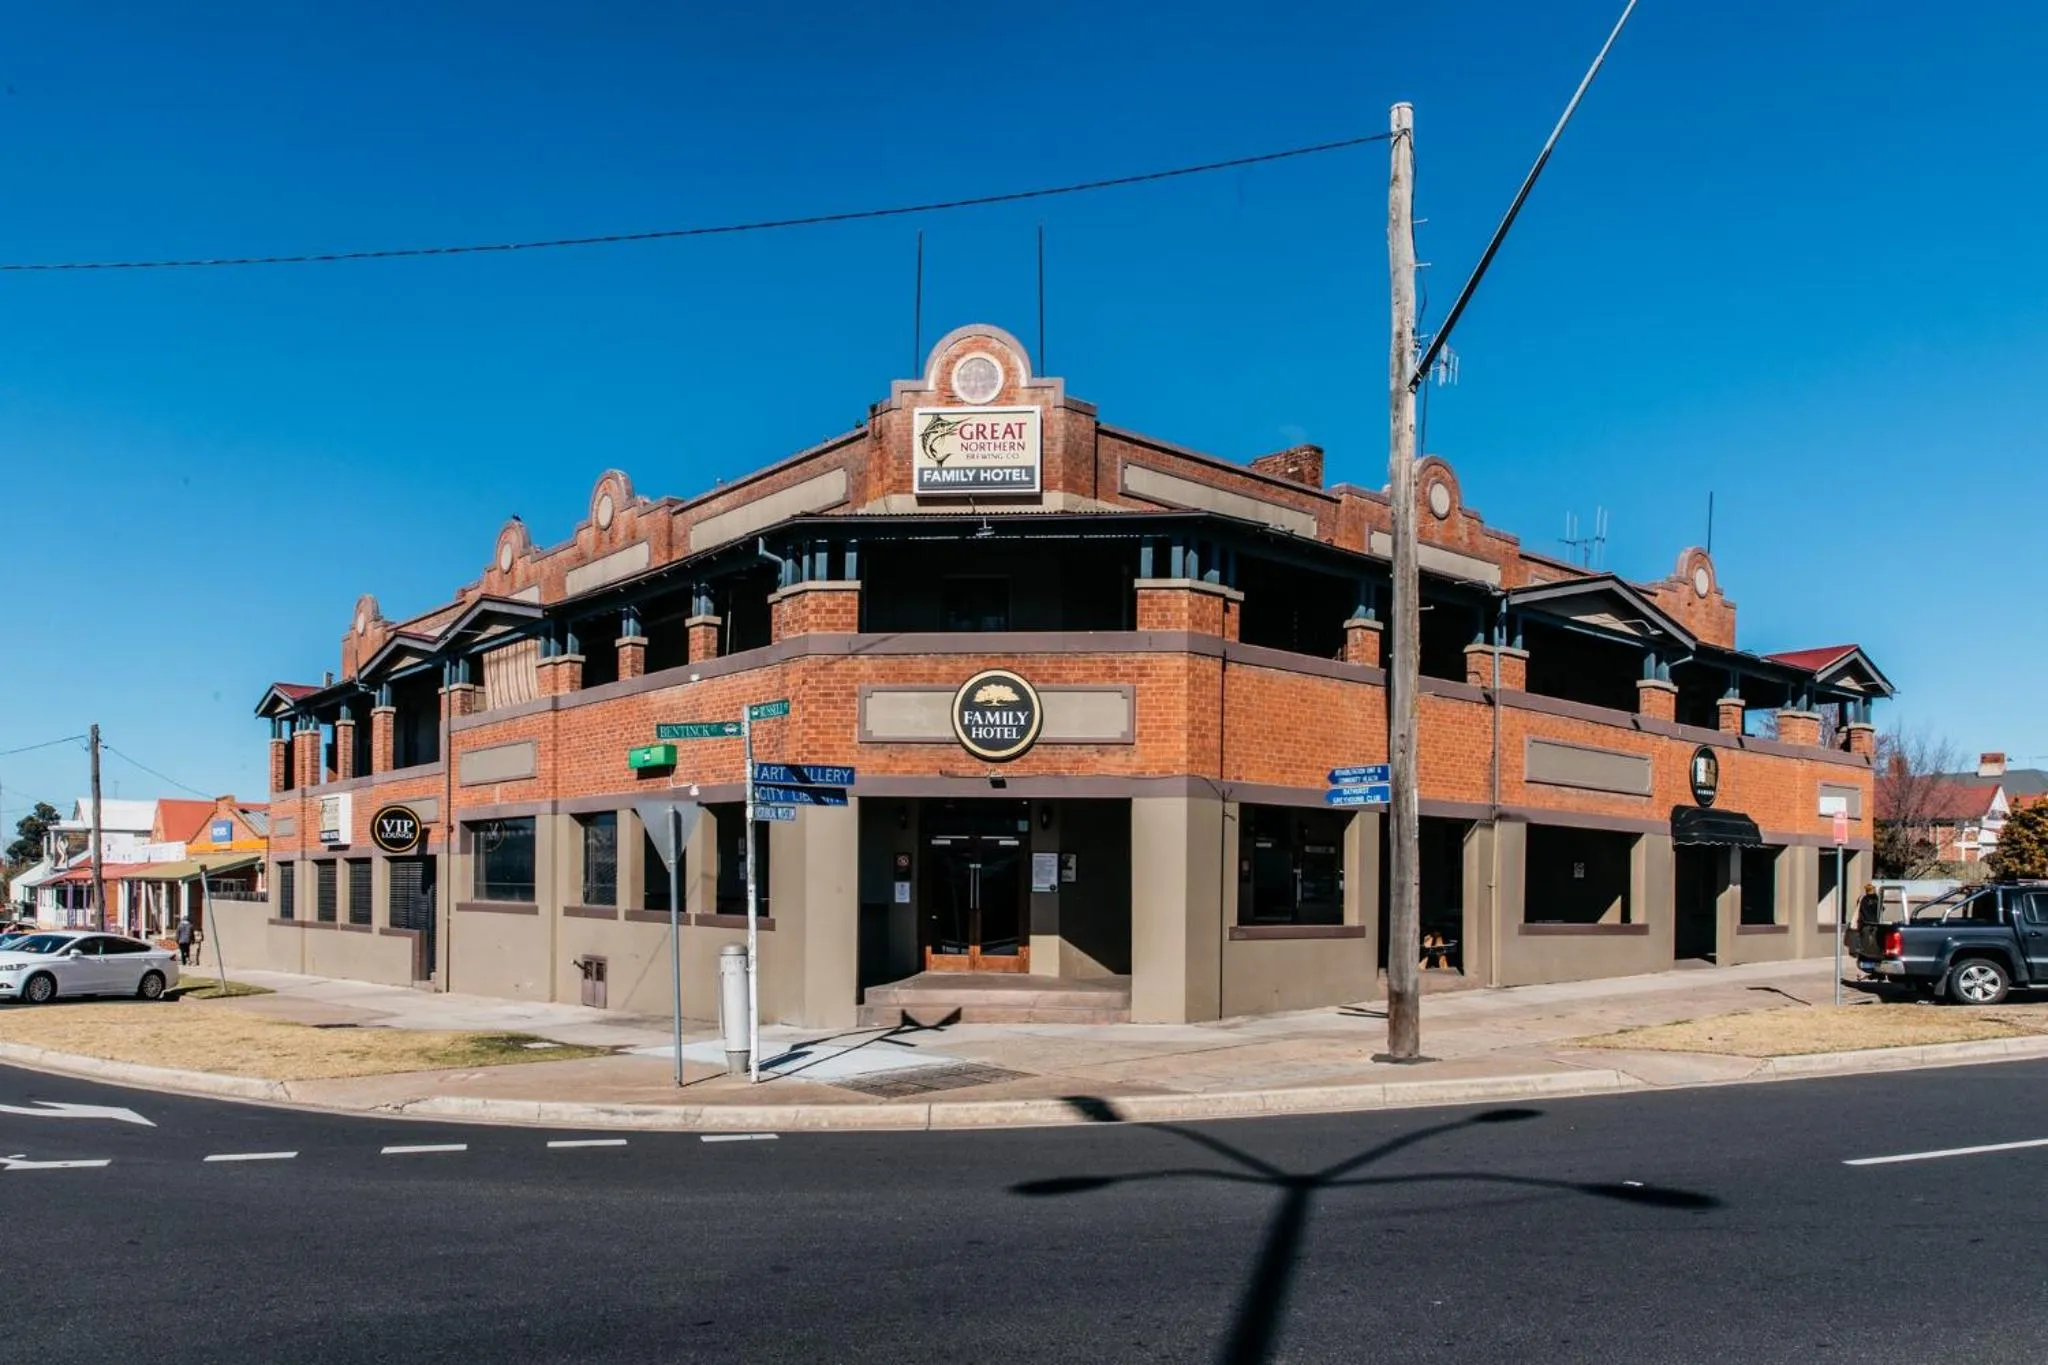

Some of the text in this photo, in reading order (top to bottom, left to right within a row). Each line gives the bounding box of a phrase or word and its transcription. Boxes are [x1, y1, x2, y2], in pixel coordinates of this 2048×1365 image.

[959, 422, 1027, 440] GREAT
[960, 441, 1026, 452] NORTHERN
[923, 468, 1030, 482] FAMILY HOTEL
[963, 711, 1029, 725] FAMILY
[660, 725, 710, 738] BENTINCK
[971, 727, 1021, 739] HOTEL
[761, 766, 786, 780] ART
[759, 787, 785, 801] CITY
[381, 819, 414, 833] VIP
